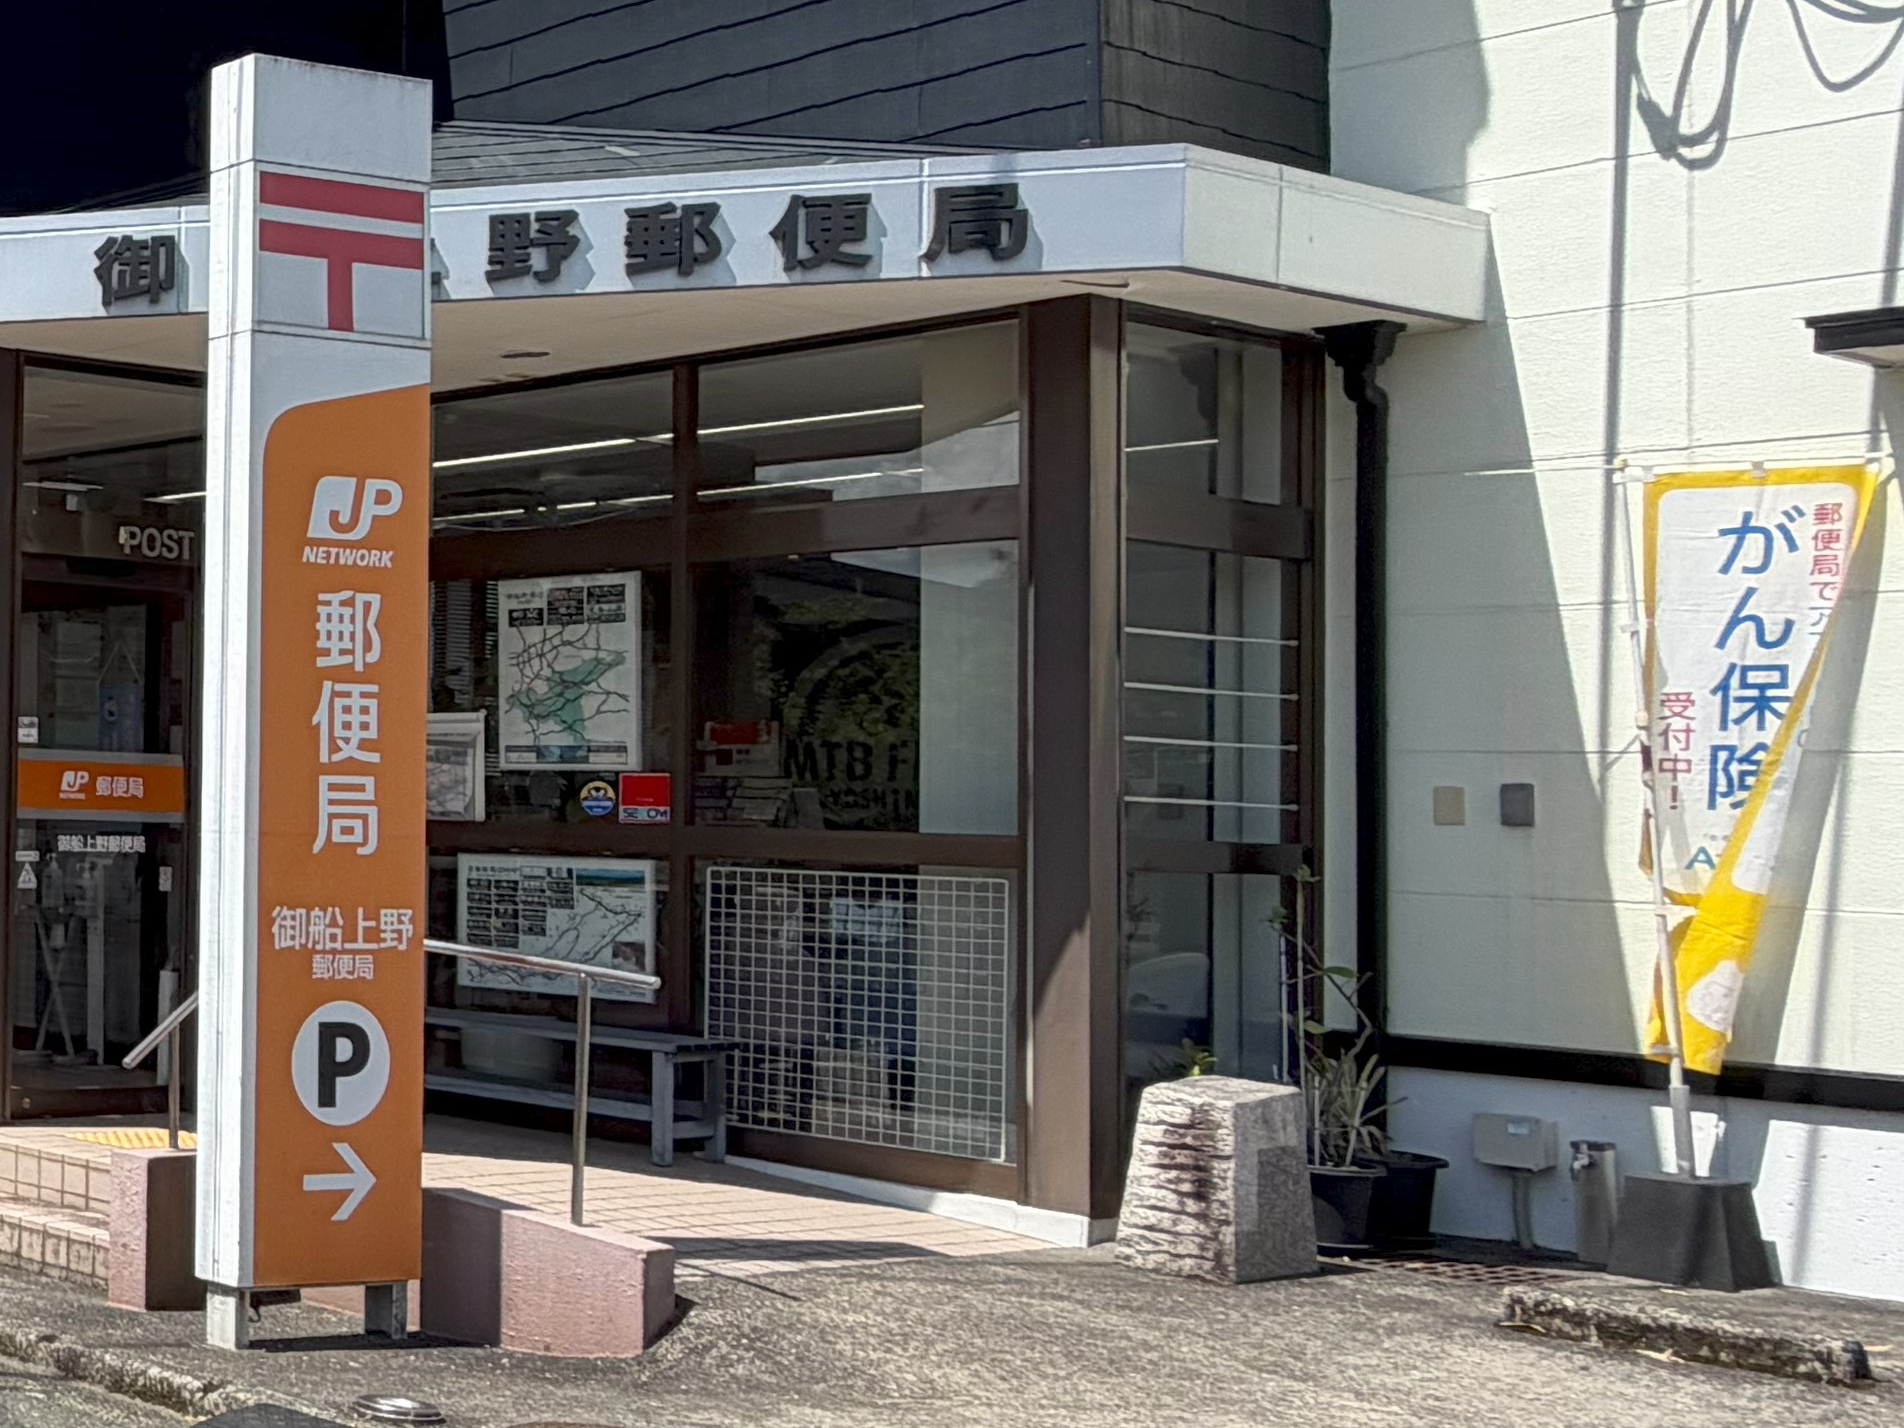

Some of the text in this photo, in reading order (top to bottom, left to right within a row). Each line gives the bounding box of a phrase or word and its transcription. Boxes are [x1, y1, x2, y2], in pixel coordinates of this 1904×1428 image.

[93, 183, 1028, 307] 御野郵便局
[306, 475, 403, 540] JP
[118, 525, 195, 560] POST
[302, 546, 394, 568] NETWORK
[312, 589, 383, 856] 郵便局
[1658, 692, 1695, 810] 受付中！
[95, 775, 144, 799] 郵便局
[57, 834, 146, 854] 御船上野郵便局
[271, 905, 414, 951] 御船上野
[311, 954, 375, 980] 郵便局
[317, 1021, 371, 1108] P
